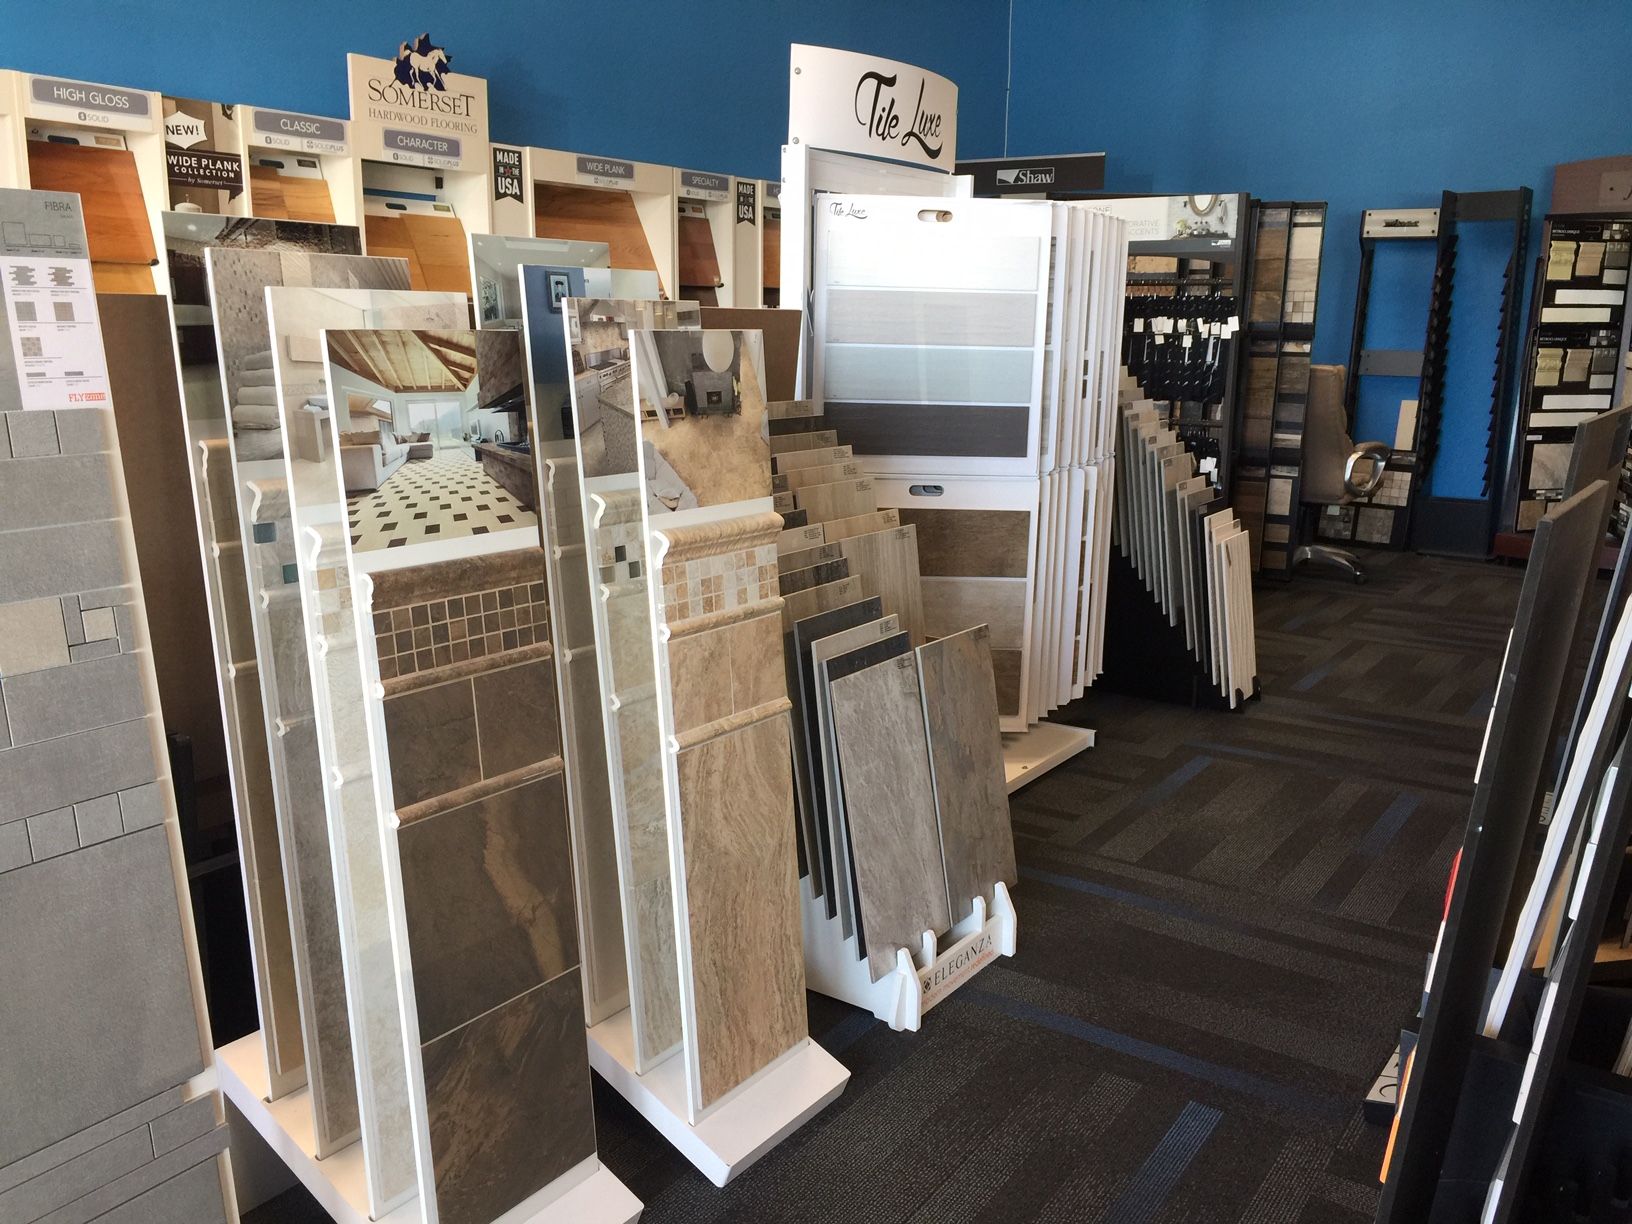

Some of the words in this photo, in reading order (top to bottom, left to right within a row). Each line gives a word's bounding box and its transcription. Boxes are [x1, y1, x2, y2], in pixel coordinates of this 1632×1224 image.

[53, 86, 86, 102] HIGH
[89, 91, 129, 109] GLOSS
[368, 78, 475, 117] SOMERSET
[368, 107, 428, 126] HARDWOOD
[431, 117, 478, 134] FLOORING
[854, 71, 900, 141] Tile
[901, 77, 943, 160] Luxe
[165, 124, 200, 136] NEW!
[280, 118, 321, 134] CLASSIC
[397, 135, 449, 153] CHARACTER
[167, 155, 198, 167] WIDE
[201, 158, 240, 172] PLANK
[496, 150, 520, 165] MADE
[174, 166, 235, 179] COLLECTION
[586, 161, 604, 173] WIDE
[604, 163, 625, 175] PLANK
[691, 176, 719, 187] SPECIALTY
[1018, 170, 1053, 185] Shaw
[497, 176, 521, 195] USA
[738, 183, 754, 194] MADE
[44, 201, 73, 212] FIBRA
[738, 205, 754, 219] USA
[934, 934, 992, 986] ELEGANZA
